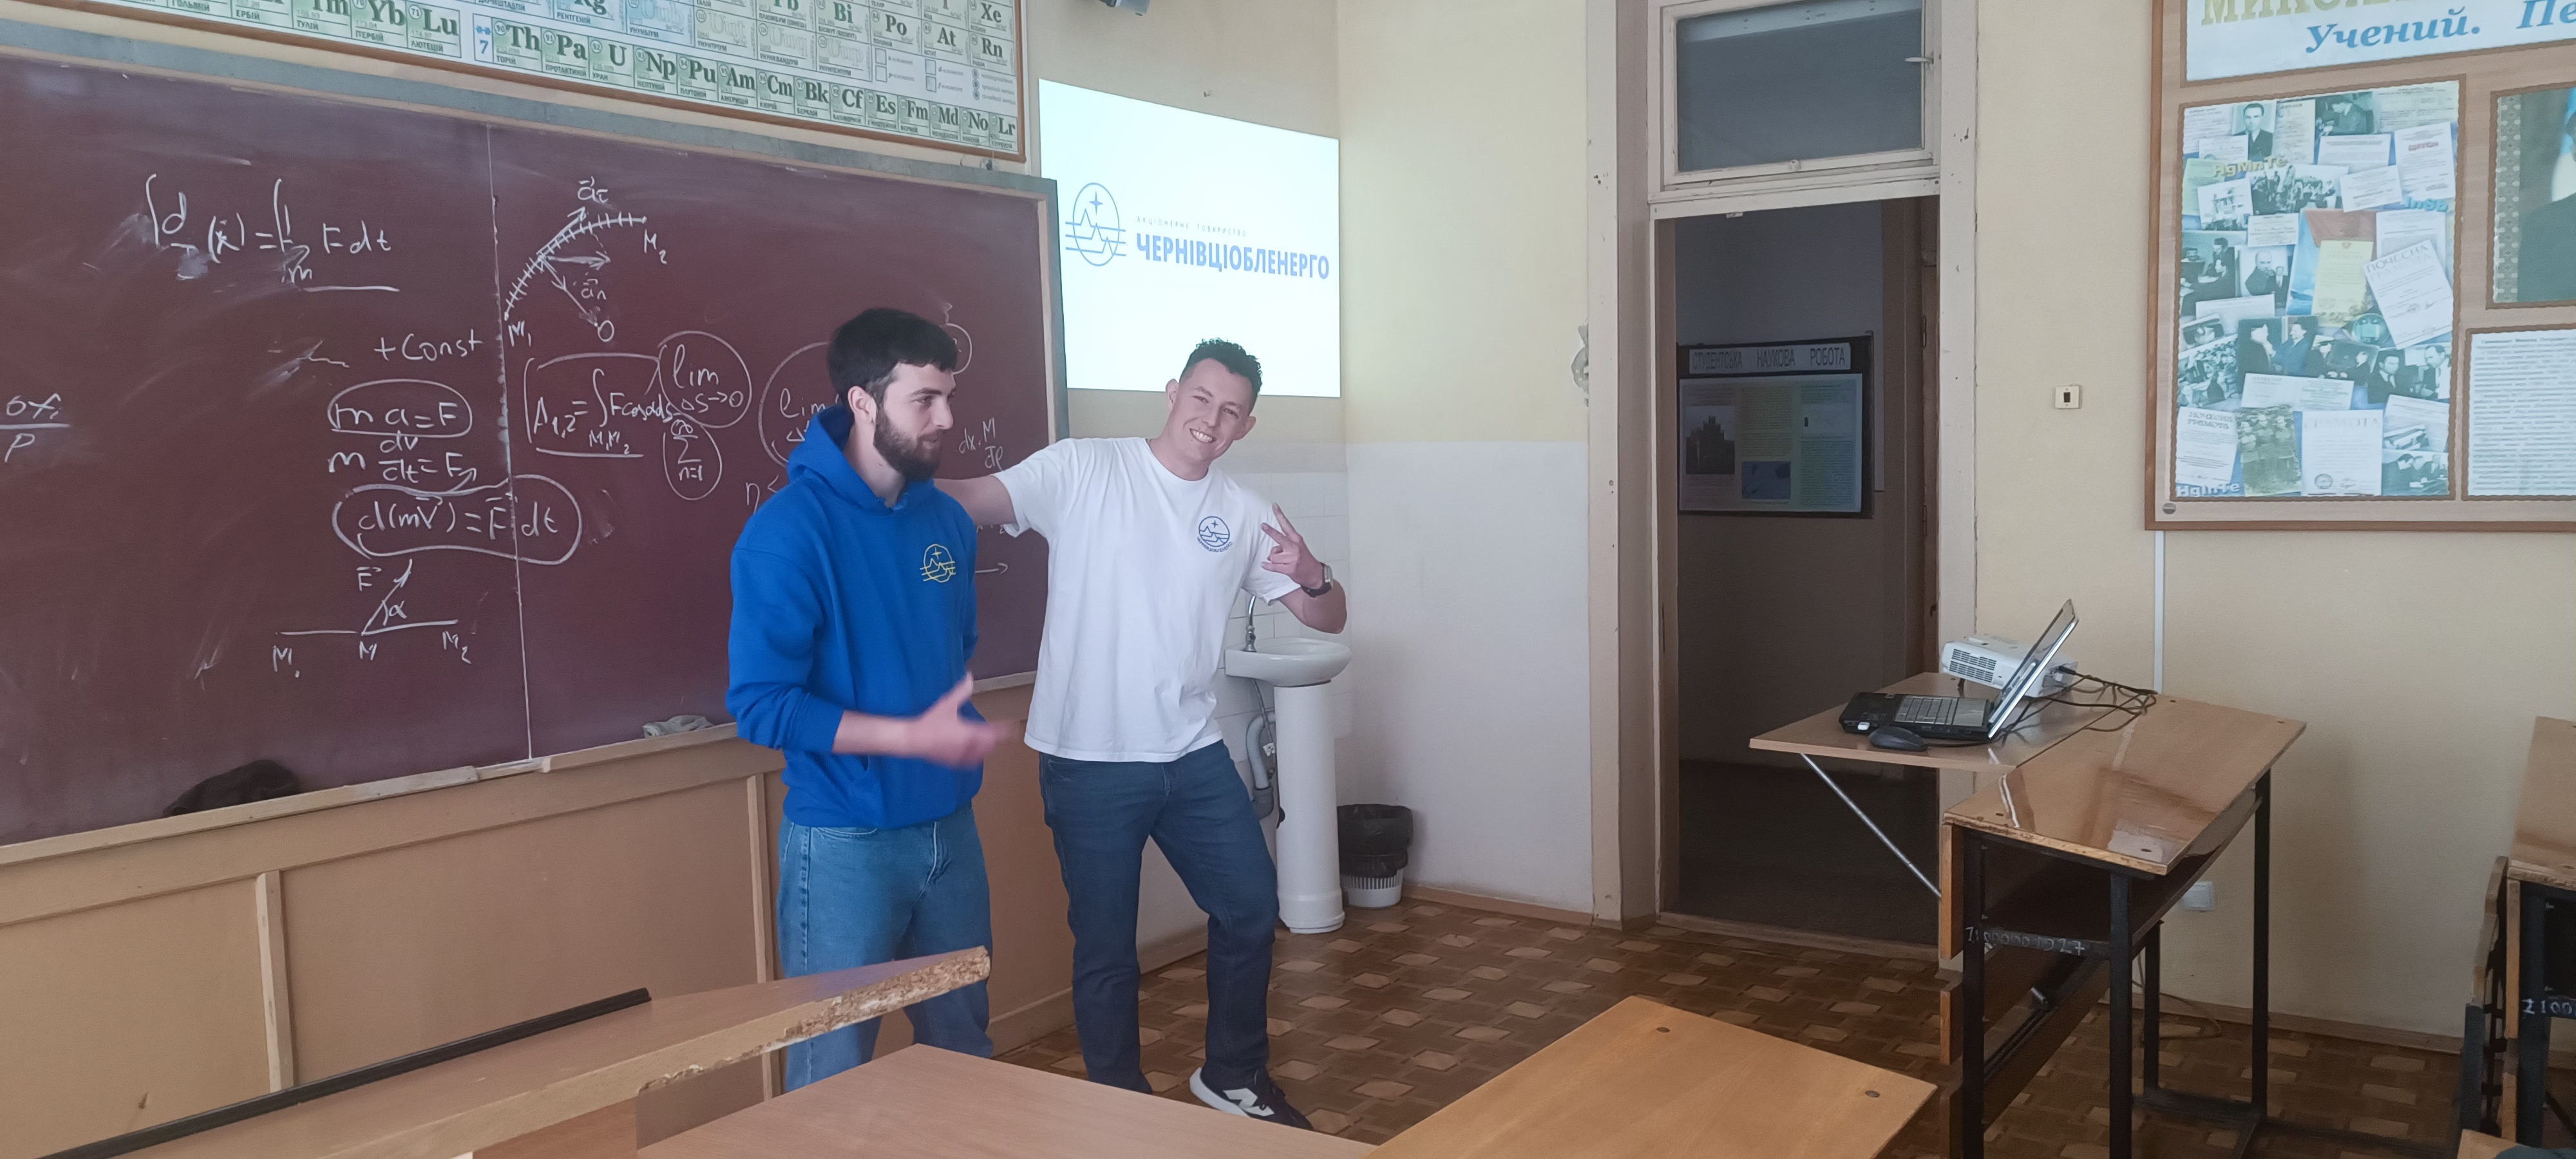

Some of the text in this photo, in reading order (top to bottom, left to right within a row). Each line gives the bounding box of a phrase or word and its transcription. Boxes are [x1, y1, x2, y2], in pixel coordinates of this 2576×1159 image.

[369, 0, 406, 26] Yb
[422, 7, 459, 36] Lu
[833, 2, 854, 24] Bi
[981, 3, 1002, 23] Xe
[296, 20, 319, 31] ТУЛІЙ
[885, 14, 907, 36] Po
[2306, 7, 2481, 53] Учений.
[479, 39, 489, 54] 7
[507, 24, 542, 52] Th
[556, 34, 588, 61] Pa
[937, 27, 957, 47] At
[981, 37, 1003, 58] Rn
[608, 43, 627, 66] U
[645, 51, 676, 81] Np
[688, 59, 717, 84] Pu
[726, 67, 757, 91] Am
[767, 75, 793, 97] Cm
[804, 81, 829, 104] Bk
[842, 88, 864, 109] Cf
[875, 94, 896, 115] Es
[907, 100, 929, 120] Fm
[938, 106, 960, 126] Md
[968, 111, 989, 131] No
[998, 117, 1016, 136] Lr
[1137, 216, 1247, 237] АКЦІОНЕРНЕ ТОВАРИСТВО
[1137, 232, 1329, 279] ЧЕРНІВЦІОБЛЕНЕРГО
[1756, 348, 1796, 368] НАУКОВА
[1810, 346, 1846, 366] РОБОТА
